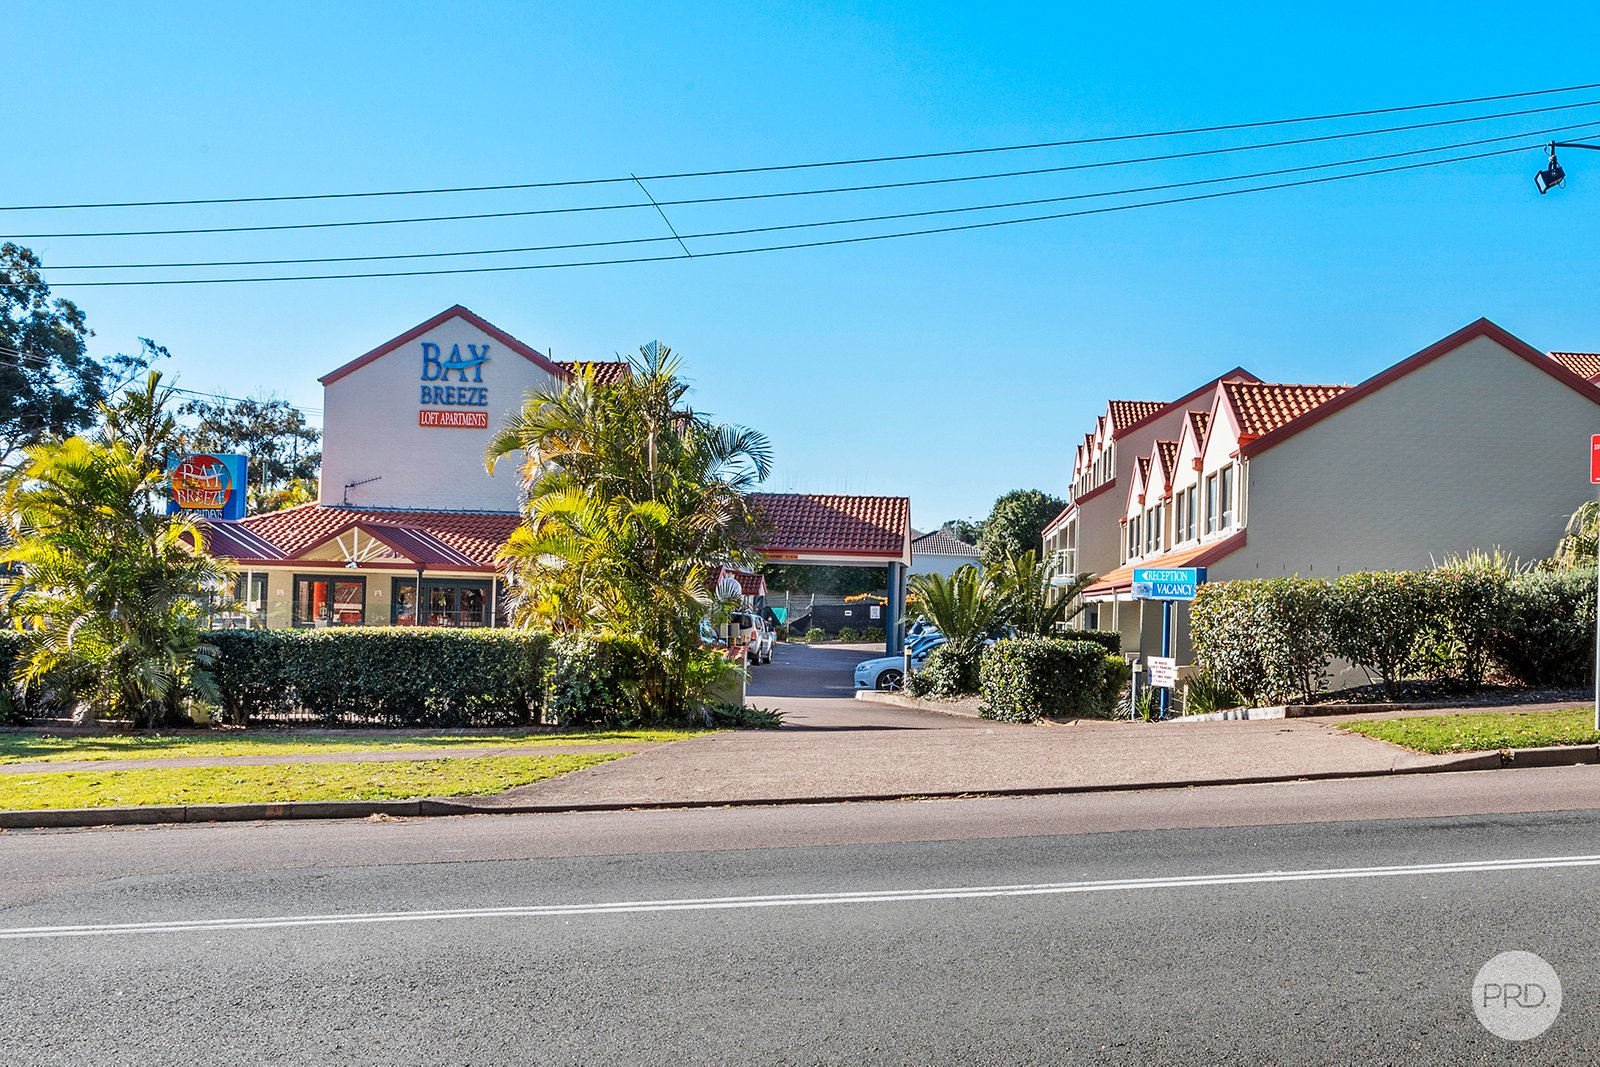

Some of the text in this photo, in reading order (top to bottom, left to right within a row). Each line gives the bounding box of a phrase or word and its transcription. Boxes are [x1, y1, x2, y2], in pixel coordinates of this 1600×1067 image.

[421, 343, 491, 383] BAY
[421, 386, 489, 407] BREEZE
[421, 411, 487, 427] LOFT APARTMENTS
[1148, 570, 1188, 582] RECEPTION
[1157, 583, 1193, 596] VACANCY
